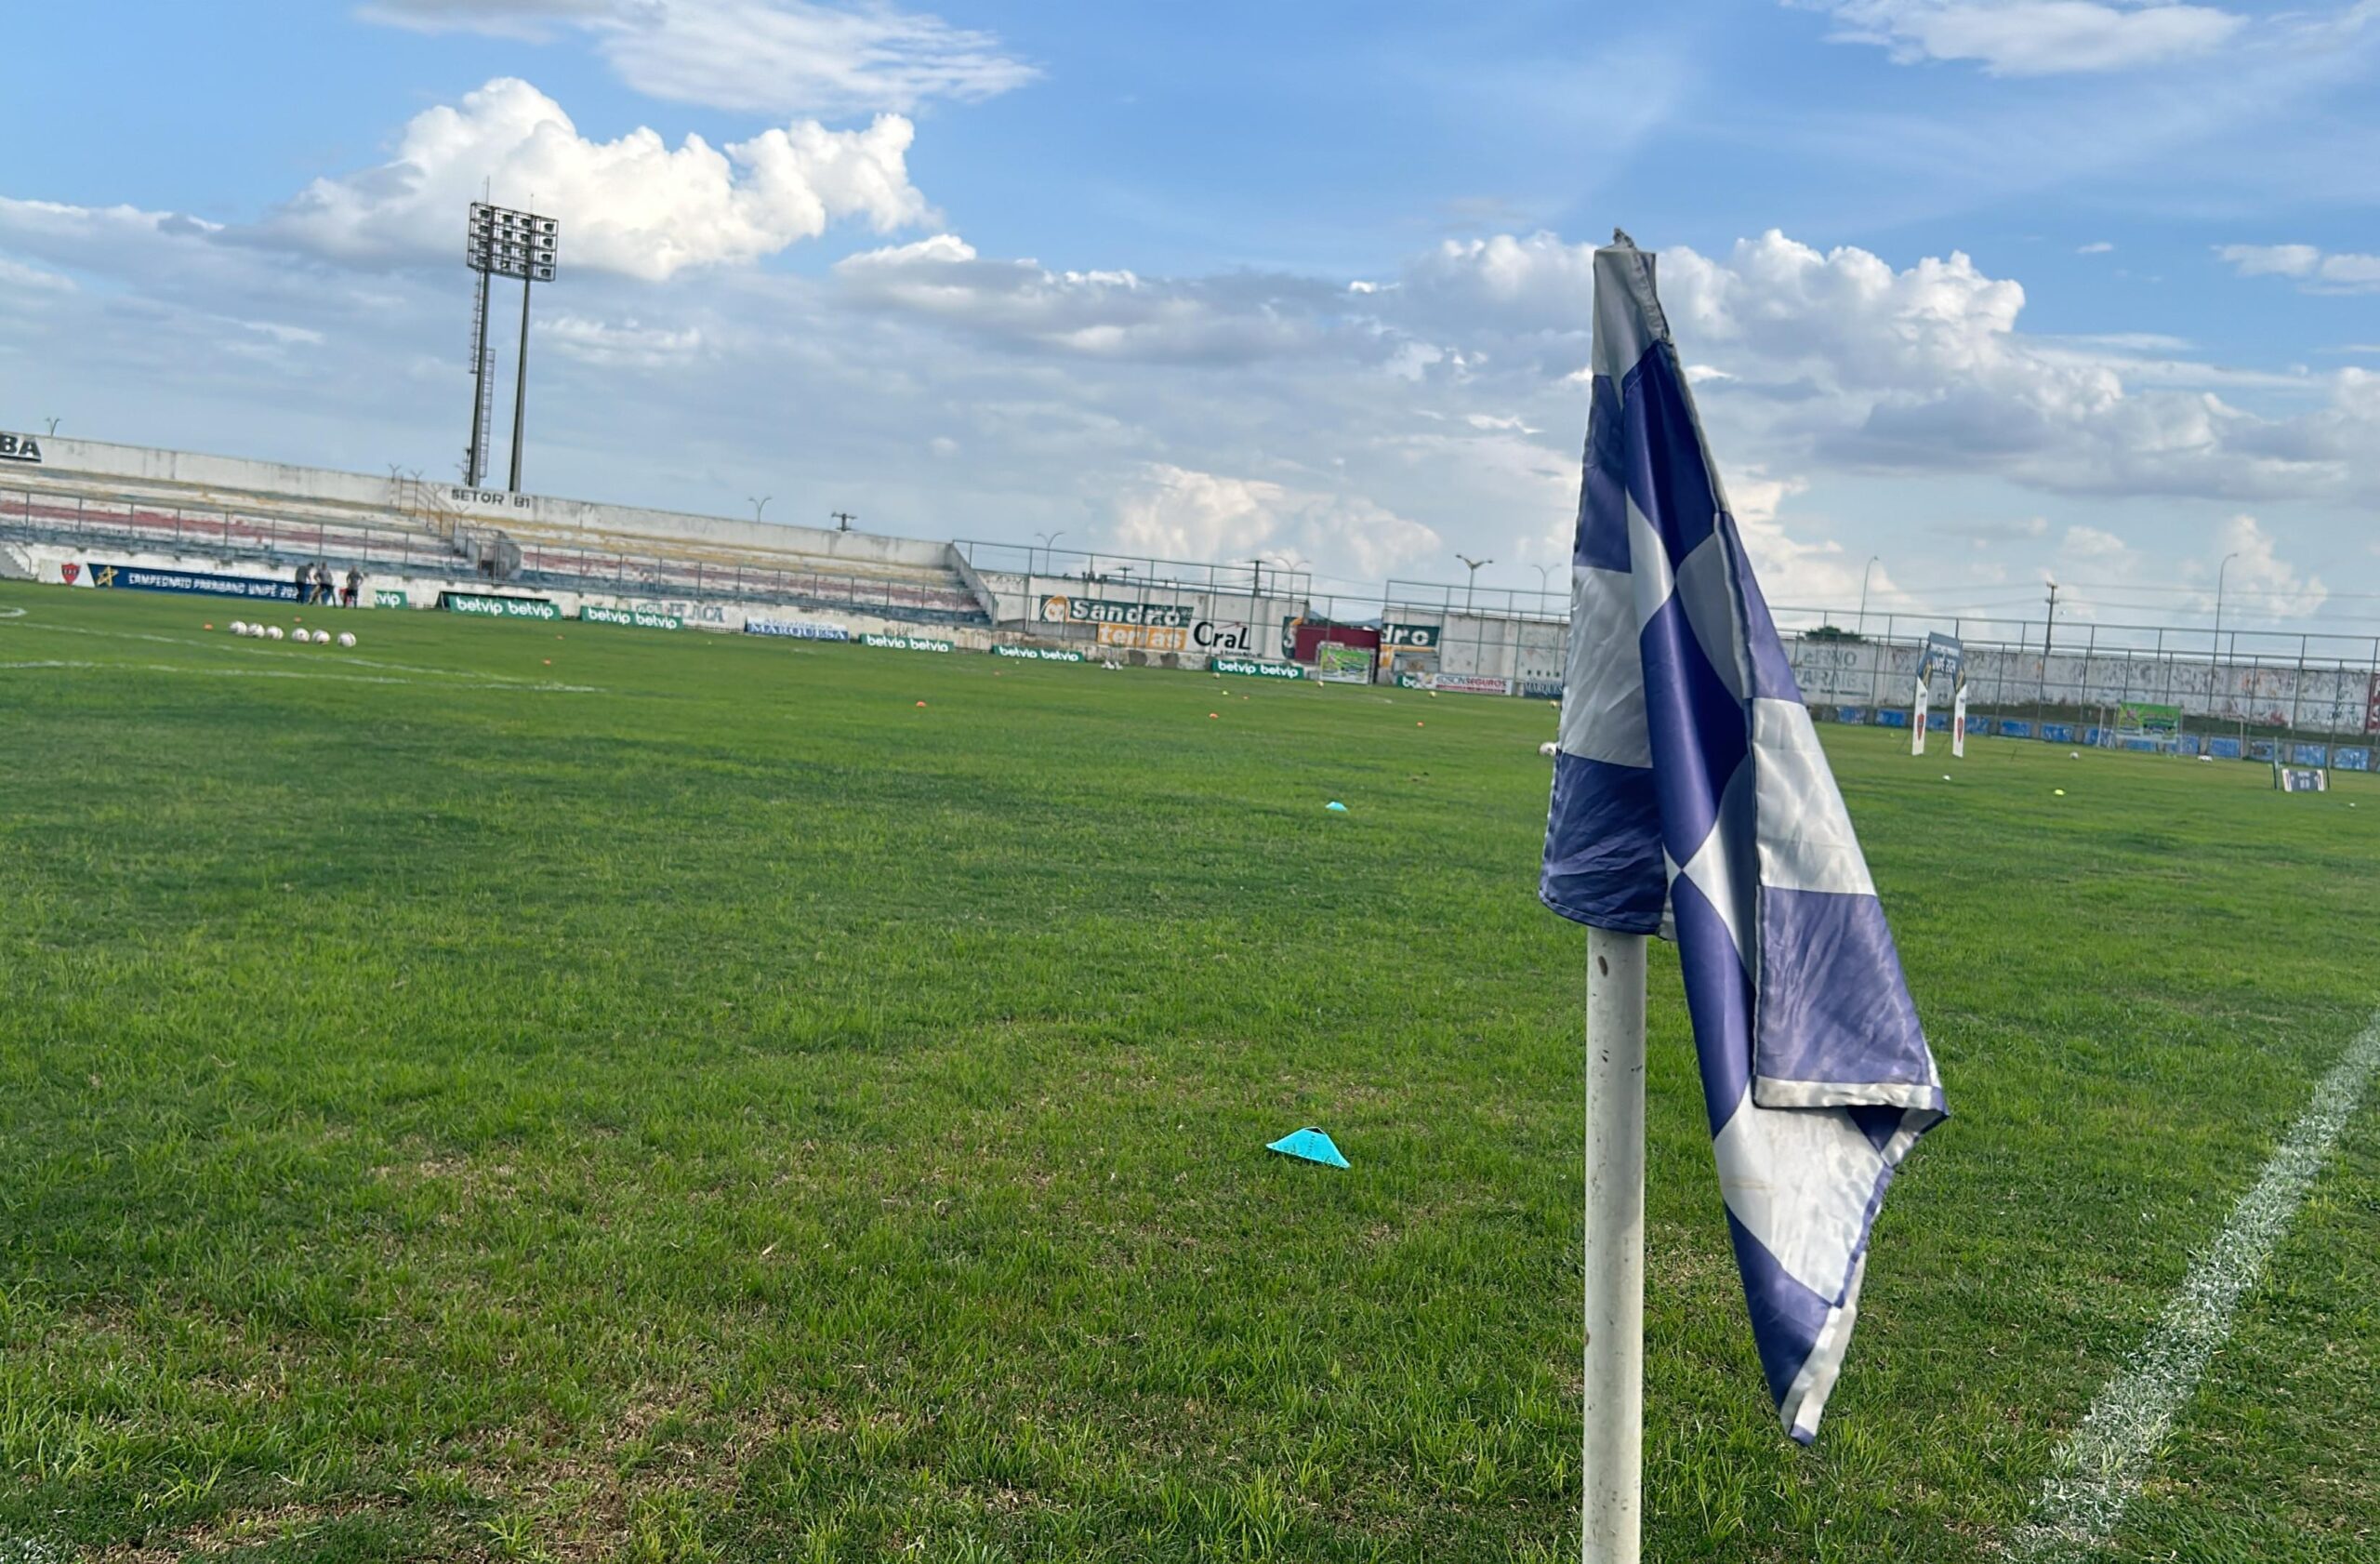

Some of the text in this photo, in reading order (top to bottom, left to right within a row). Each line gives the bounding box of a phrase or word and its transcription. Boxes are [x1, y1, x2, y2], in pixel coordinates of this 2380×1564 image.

[451, 488, 505, 505] SETOR
[456, 596, 553, 620] betvip betvip
[588, 607, 678, 630] betvip betvip
[1072, 599, 1181, 627] Sandro
[1217, 659, 1299, 678] betvip betvip
